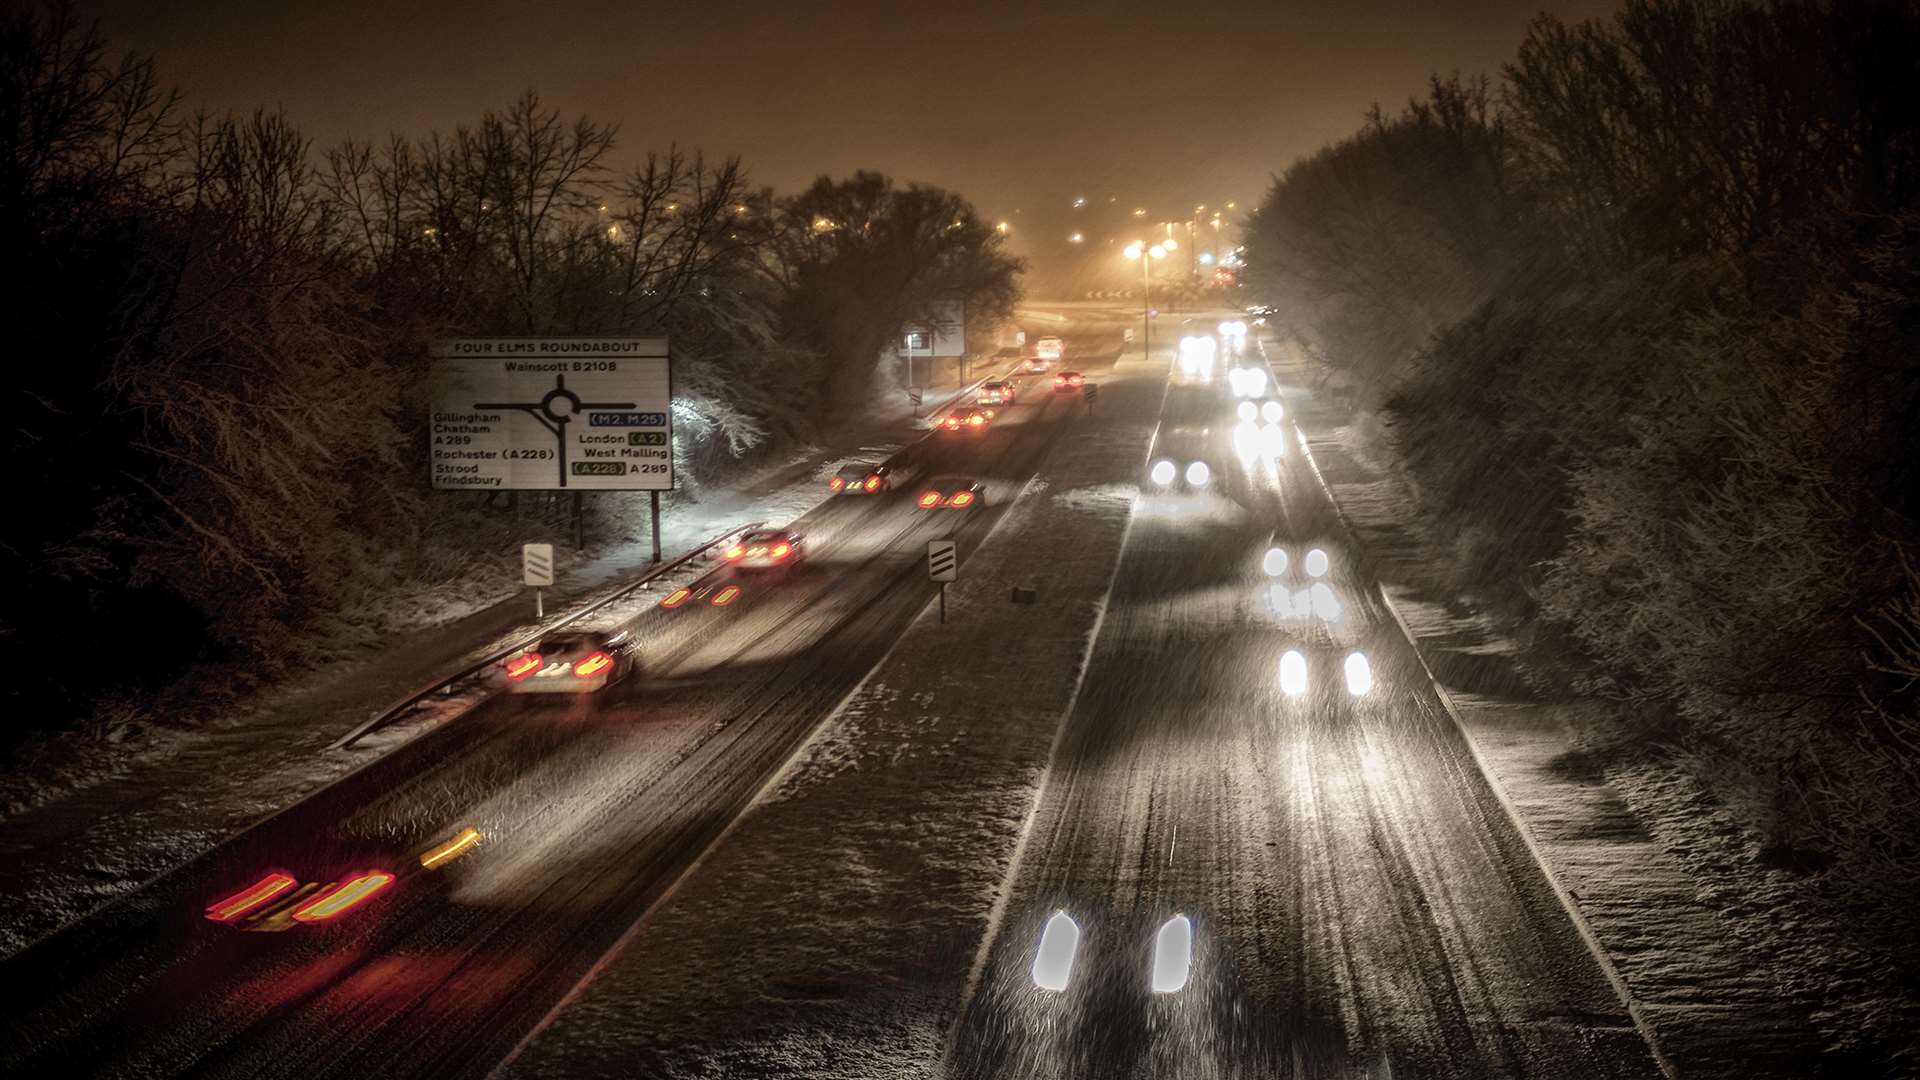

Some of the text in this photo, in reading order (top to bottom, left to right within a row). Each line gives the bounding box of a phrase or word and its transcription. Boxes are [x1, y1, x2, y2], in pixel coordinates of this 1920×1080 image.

[454, 342, 640, 352] FOUR ELMS ROUNDABOUT
[504, 362, 616, 372] Wainscott B2108
[434, 412, 501, 424] Gillingham
[628, 414, 664, 424] M25)
[434, 424, 490, 433] Chatham
[579, 434, 625, 444] London
[434, 450, 497, 459] Rochester
[584, 448, 668, 459] West Malling
[436, 464, 479, 473] Strood
[435, 476, 502, 486] Frindsbury
